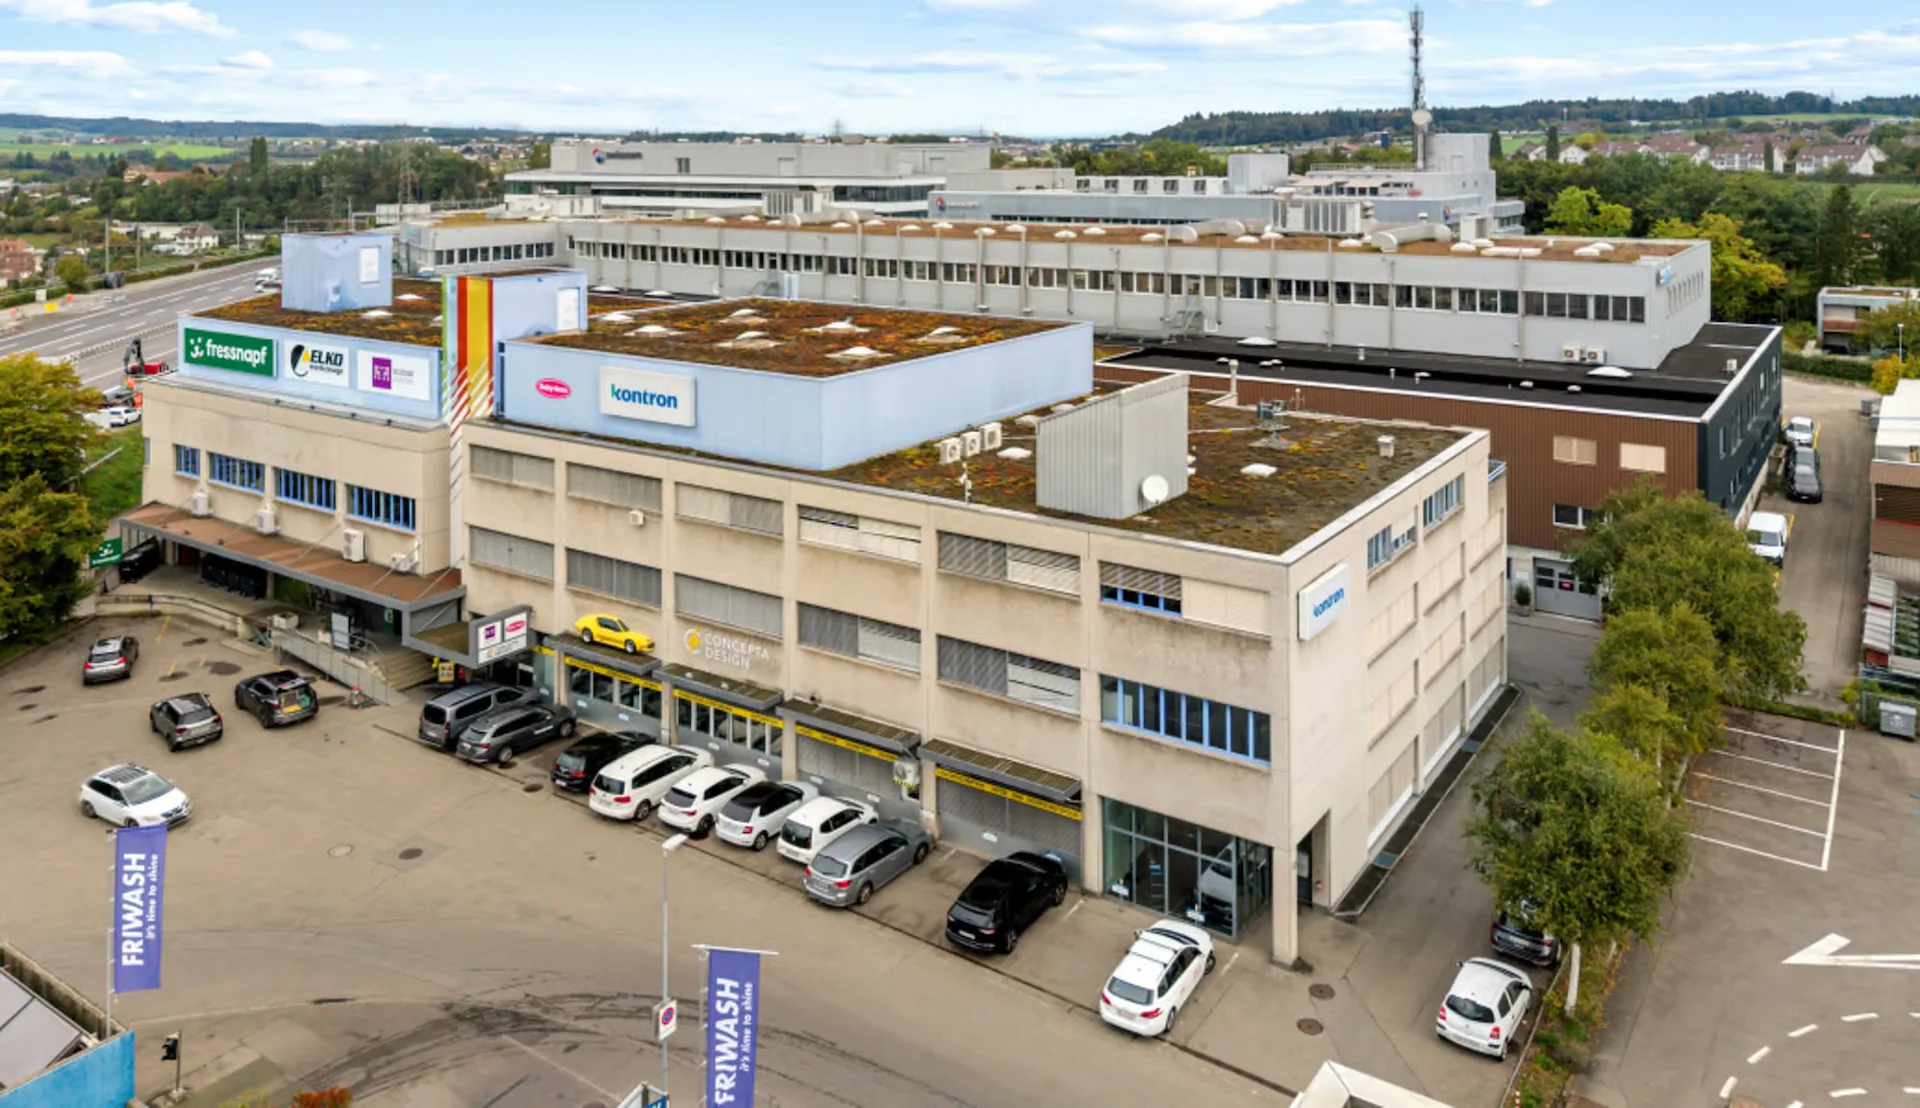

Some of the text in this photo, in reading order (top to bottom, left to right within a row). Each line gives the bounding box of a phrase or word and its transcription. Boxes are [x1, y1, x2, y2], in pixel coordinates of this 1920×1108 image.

[206, 338, 268, 368] fressnapf
[310, 349, 344, 367] ELKO
[610, 383, 678, 409] kontron
[704, 632, 770, 660] CONCEPTA
[705, 646, 751, 670] DESIGN
[148, 885, 157, 895] to
[122, 853, 145, 966] FRIWASH
[146, 899, 156, 921] time
[742, 982, 753, 1010] shine
[743, 1014, 752, 1025] to
[715, 977, 740, 1105] FRIWASH
[741, 1028, 751, 1053] time
